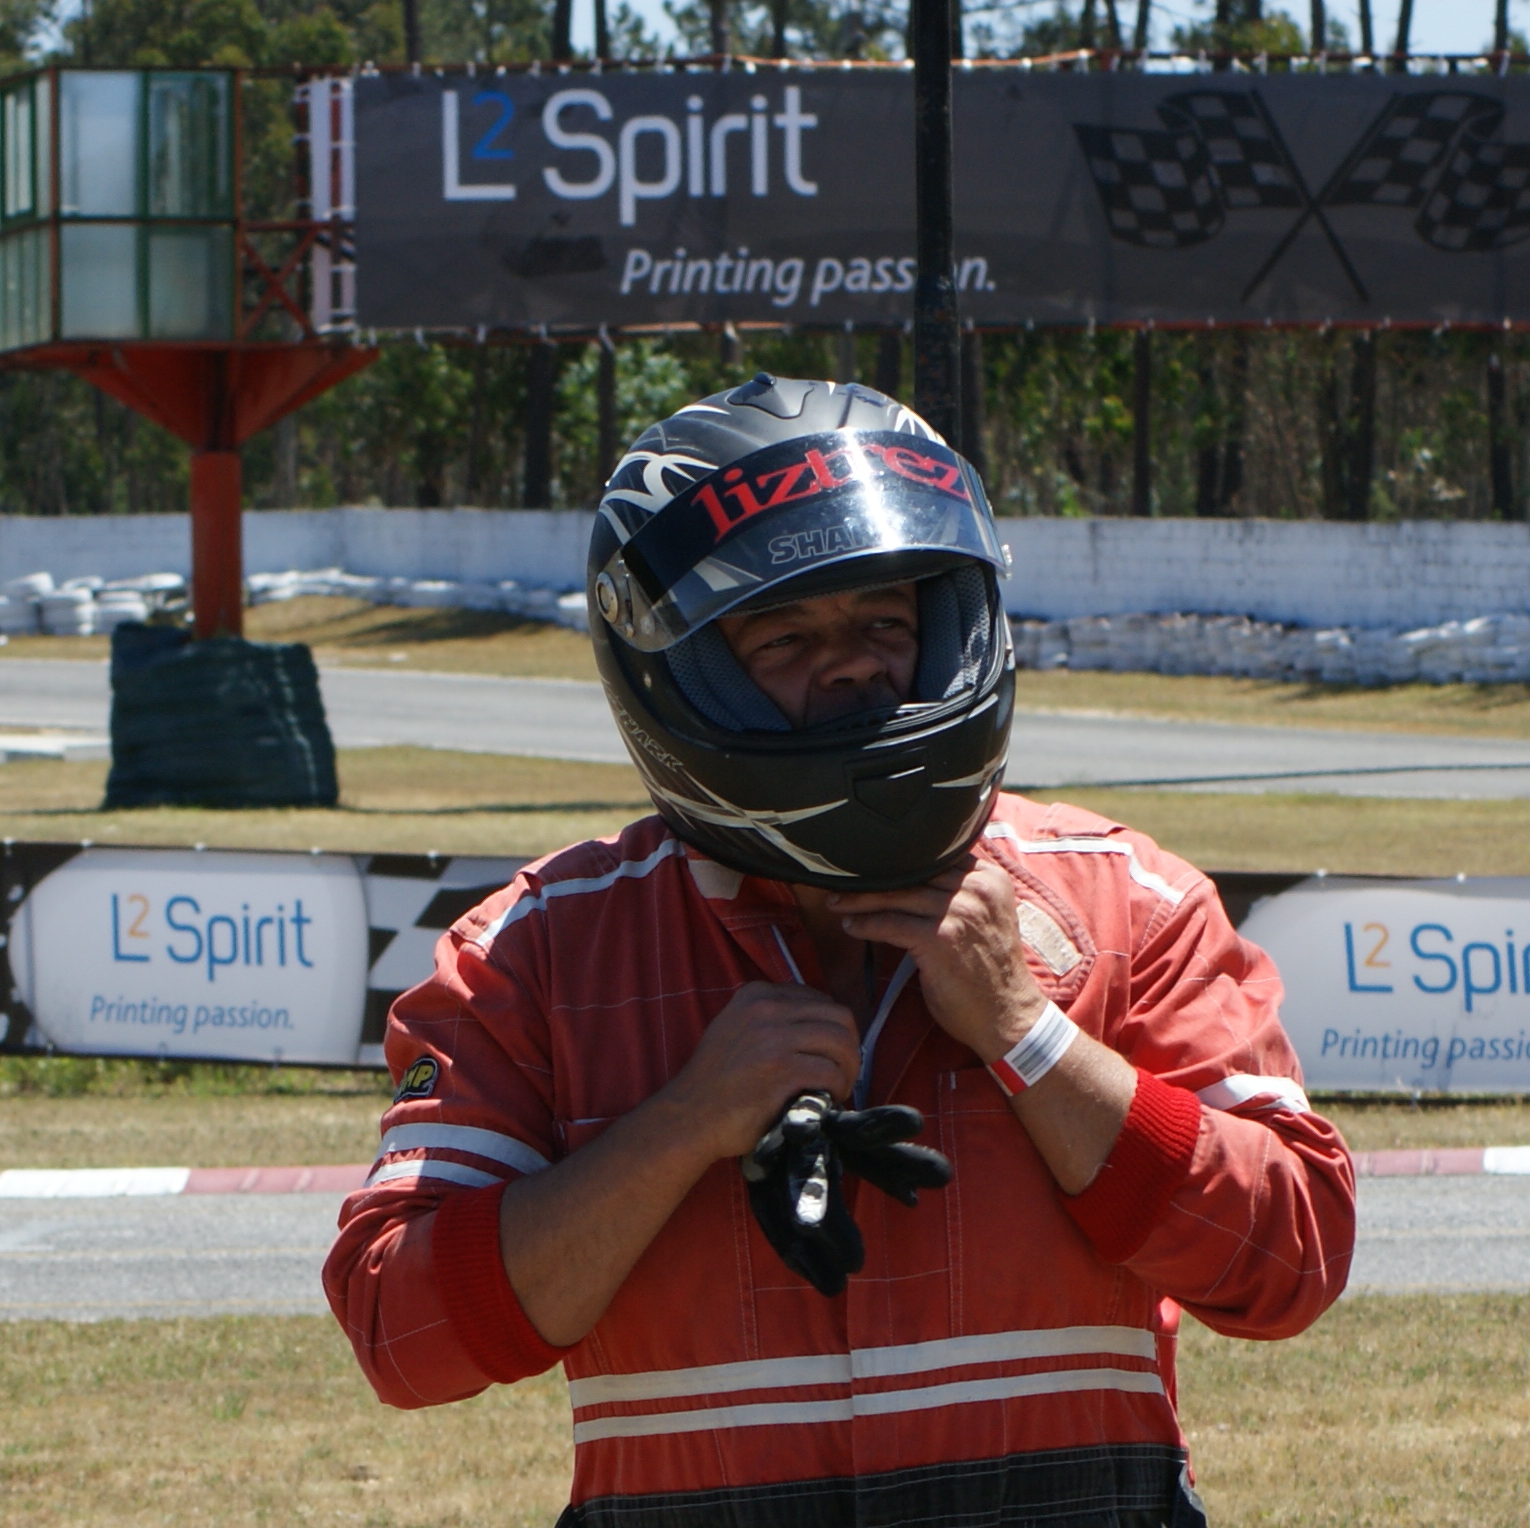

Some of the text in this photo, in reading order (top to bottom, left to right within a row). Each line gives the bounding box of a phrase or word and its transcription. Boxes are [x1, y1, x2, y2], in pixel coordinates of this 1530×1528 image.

[542, 86, 818, 227] Spirit
[620, 247, 997, 308] Printing passn.
[165, 895, 314, 982] Spirit
[90, 994, 295, 1034] Printing passion.
[1320, 1028, 1440, 1070] Printing
